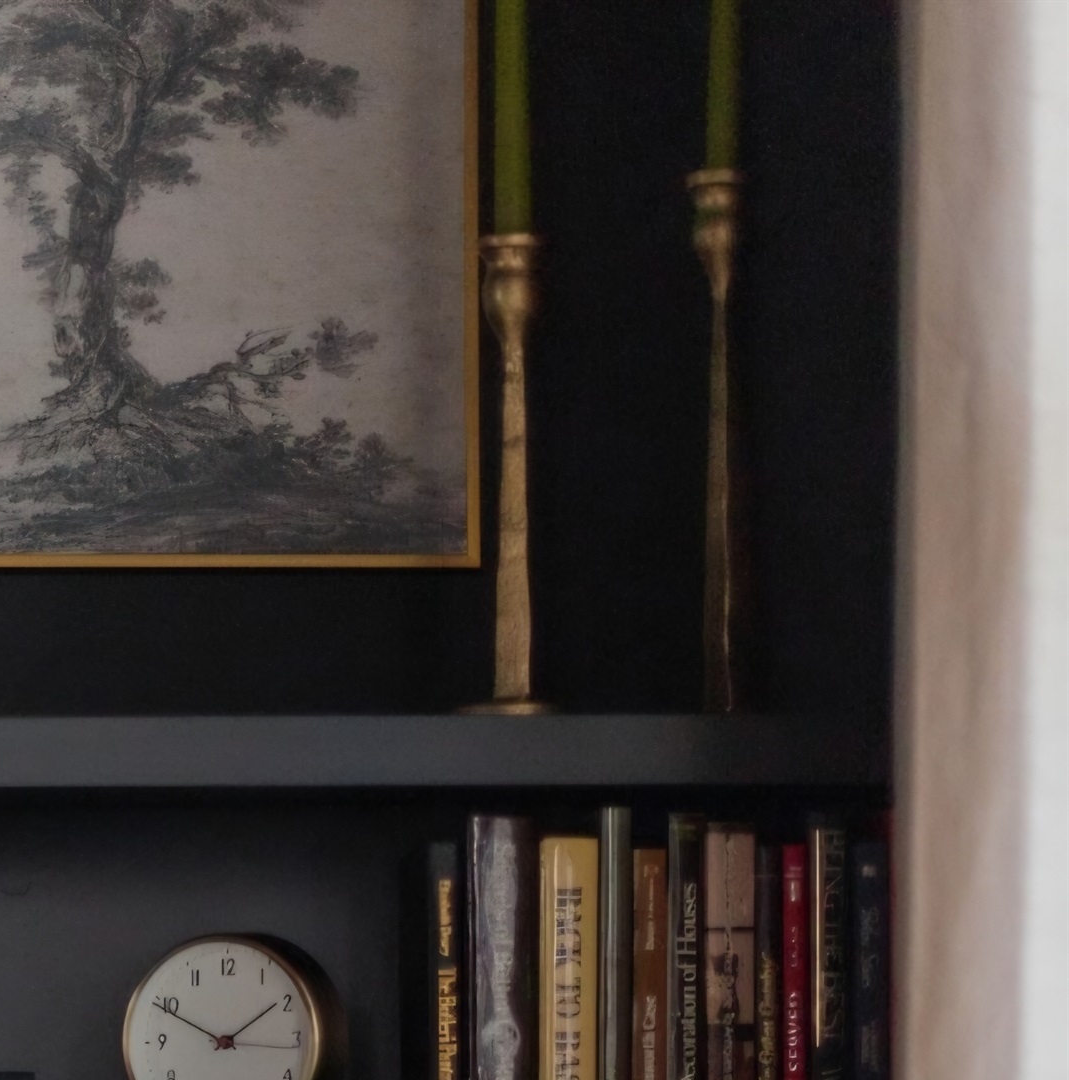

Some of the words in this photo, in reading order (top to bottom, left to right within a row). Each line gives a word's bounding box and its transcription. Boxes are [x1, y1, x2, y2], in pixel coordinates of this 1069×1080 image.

[675, 881, 697, 956] Houses
[221, 958, 236, 976] 12
[675, 963, 697, 982] of
[191, 969, 200, 986] 11
[260, 968, 264, 985] 1
[163, 997, 179, 1015] 10
[283, 994, 292, 1012] 2
[555, 977, 582, 1019] TO
[157, 1033, 167, 1051] 9
[292, 1031, 301, 1048] 3
